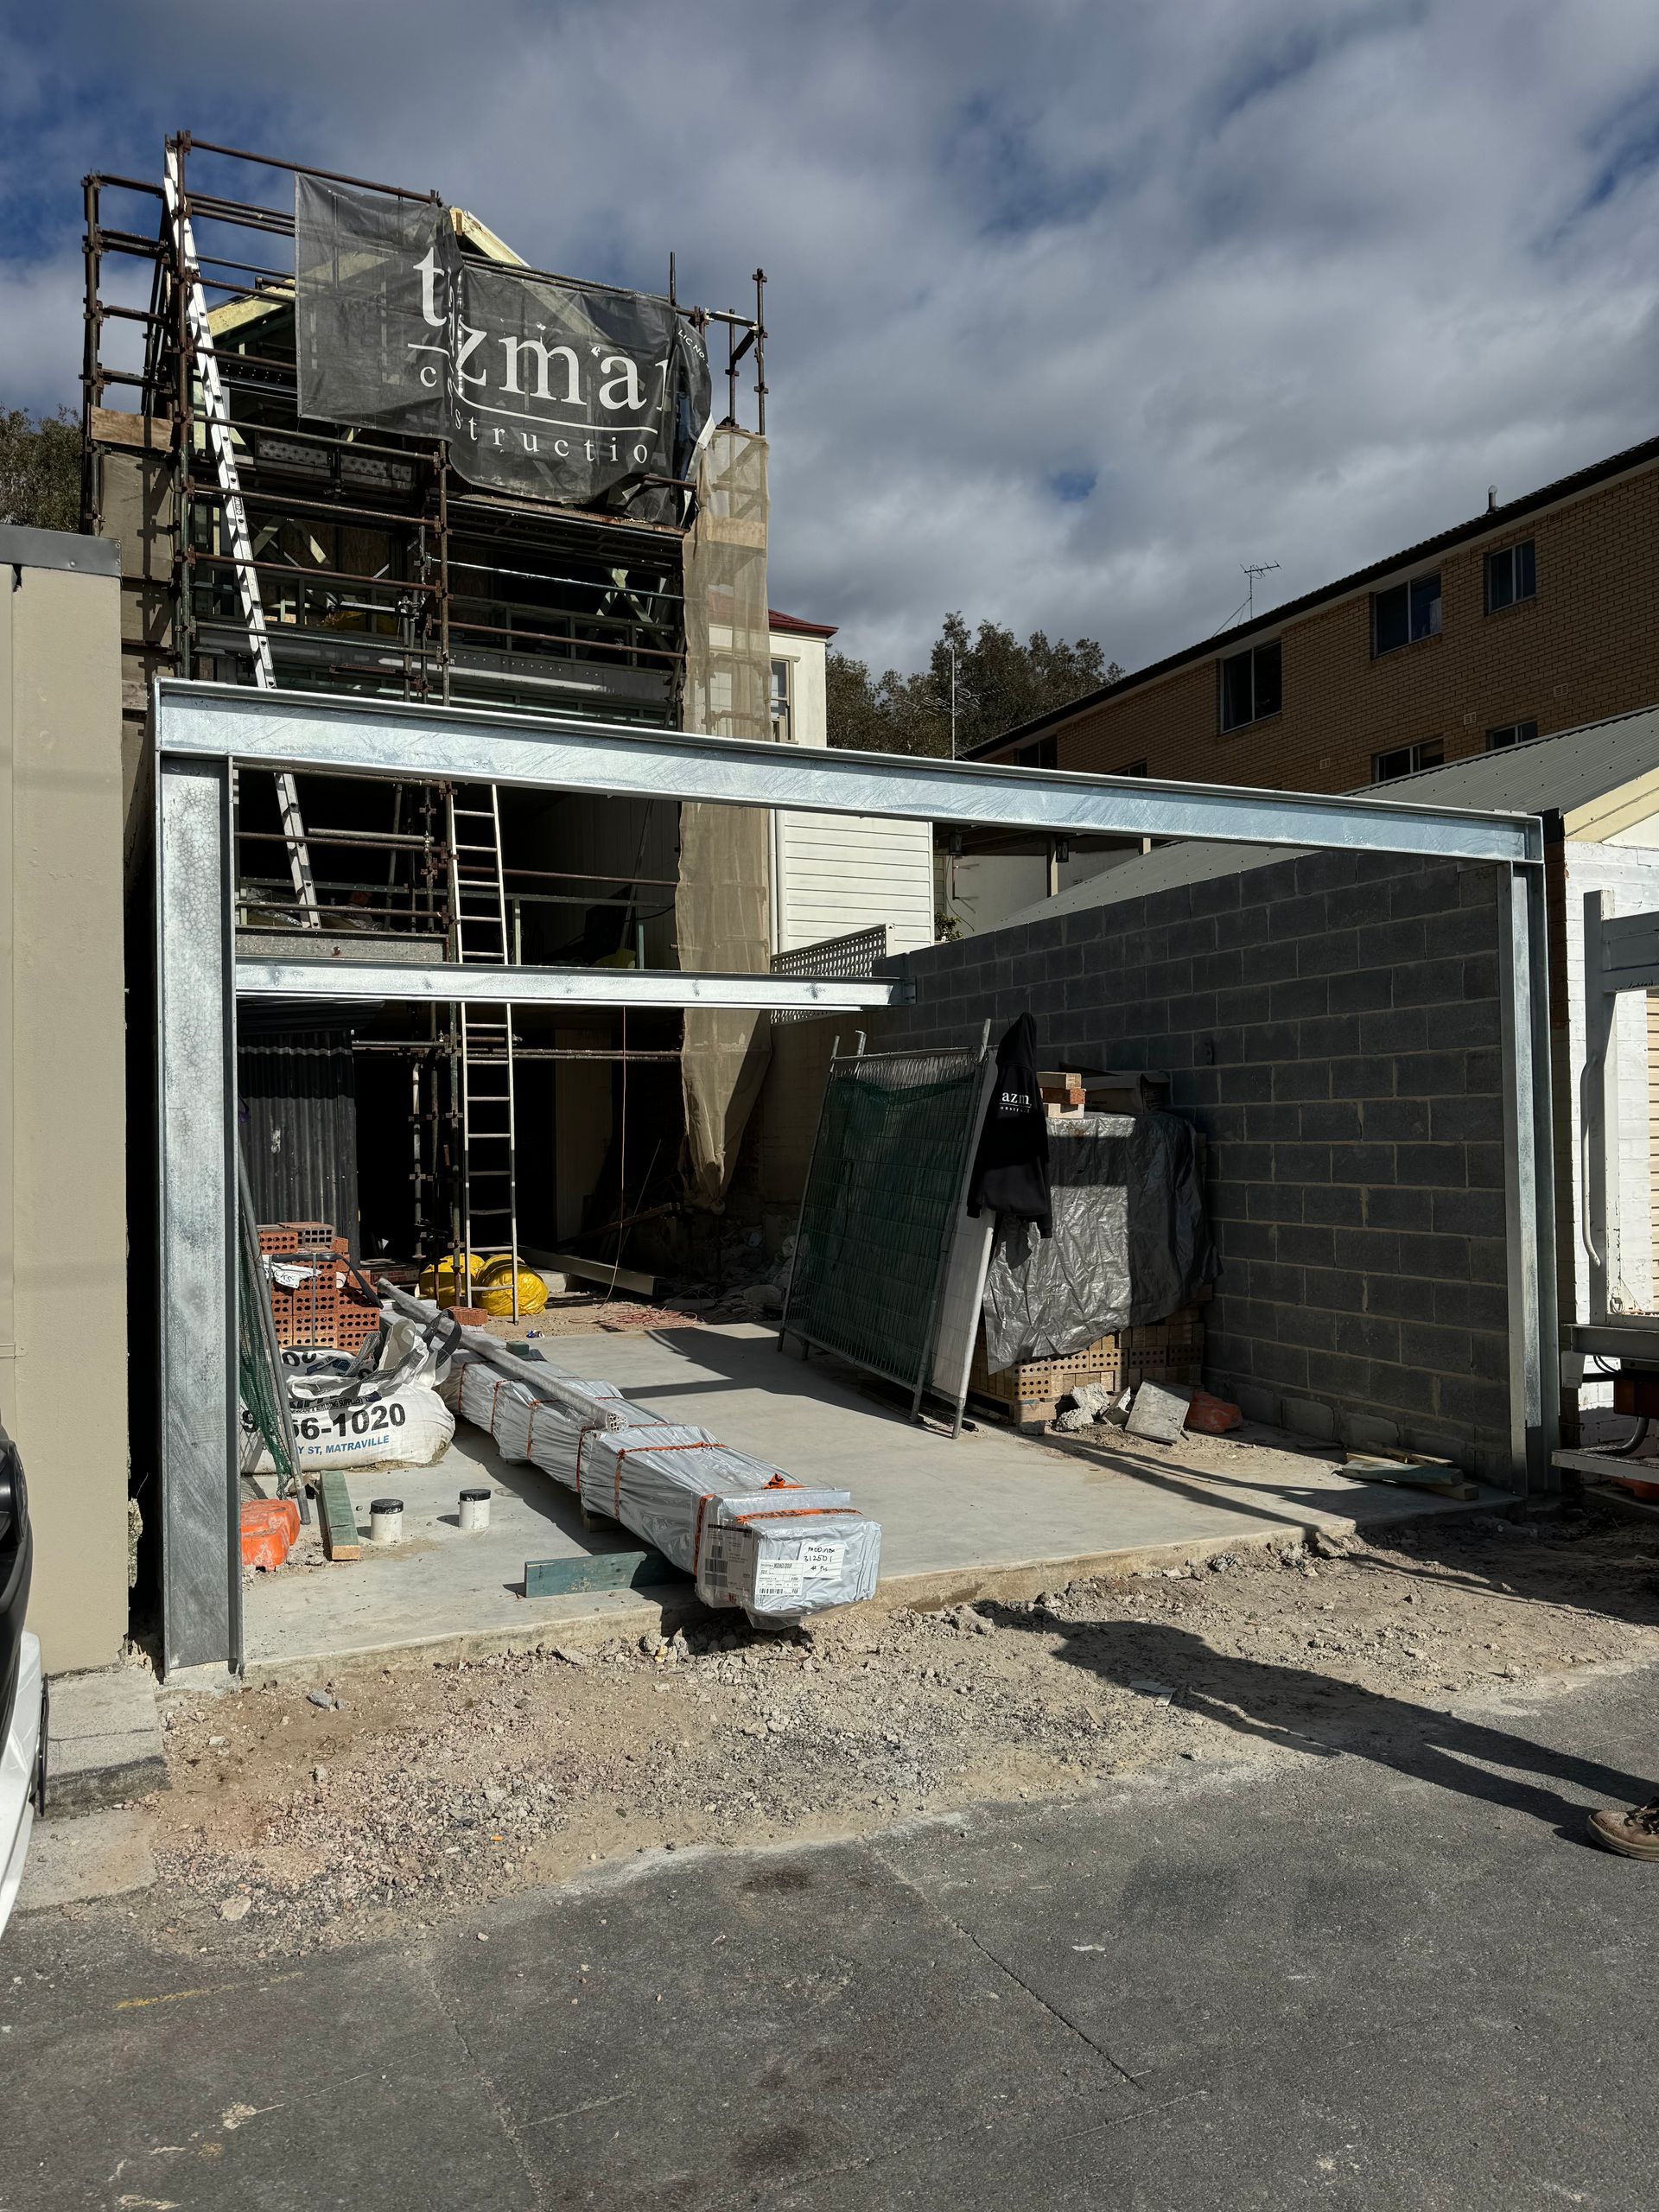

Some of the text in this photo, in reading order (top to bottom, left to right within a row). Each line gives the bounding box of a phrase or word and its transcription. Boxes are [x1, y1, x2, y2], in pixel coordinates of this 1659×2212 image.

[677, 329, 705, 361] LIC No.
[307, 1446, 322, 1456] ST,
[325, 1434, 390, 1454] MATRAVILLE
